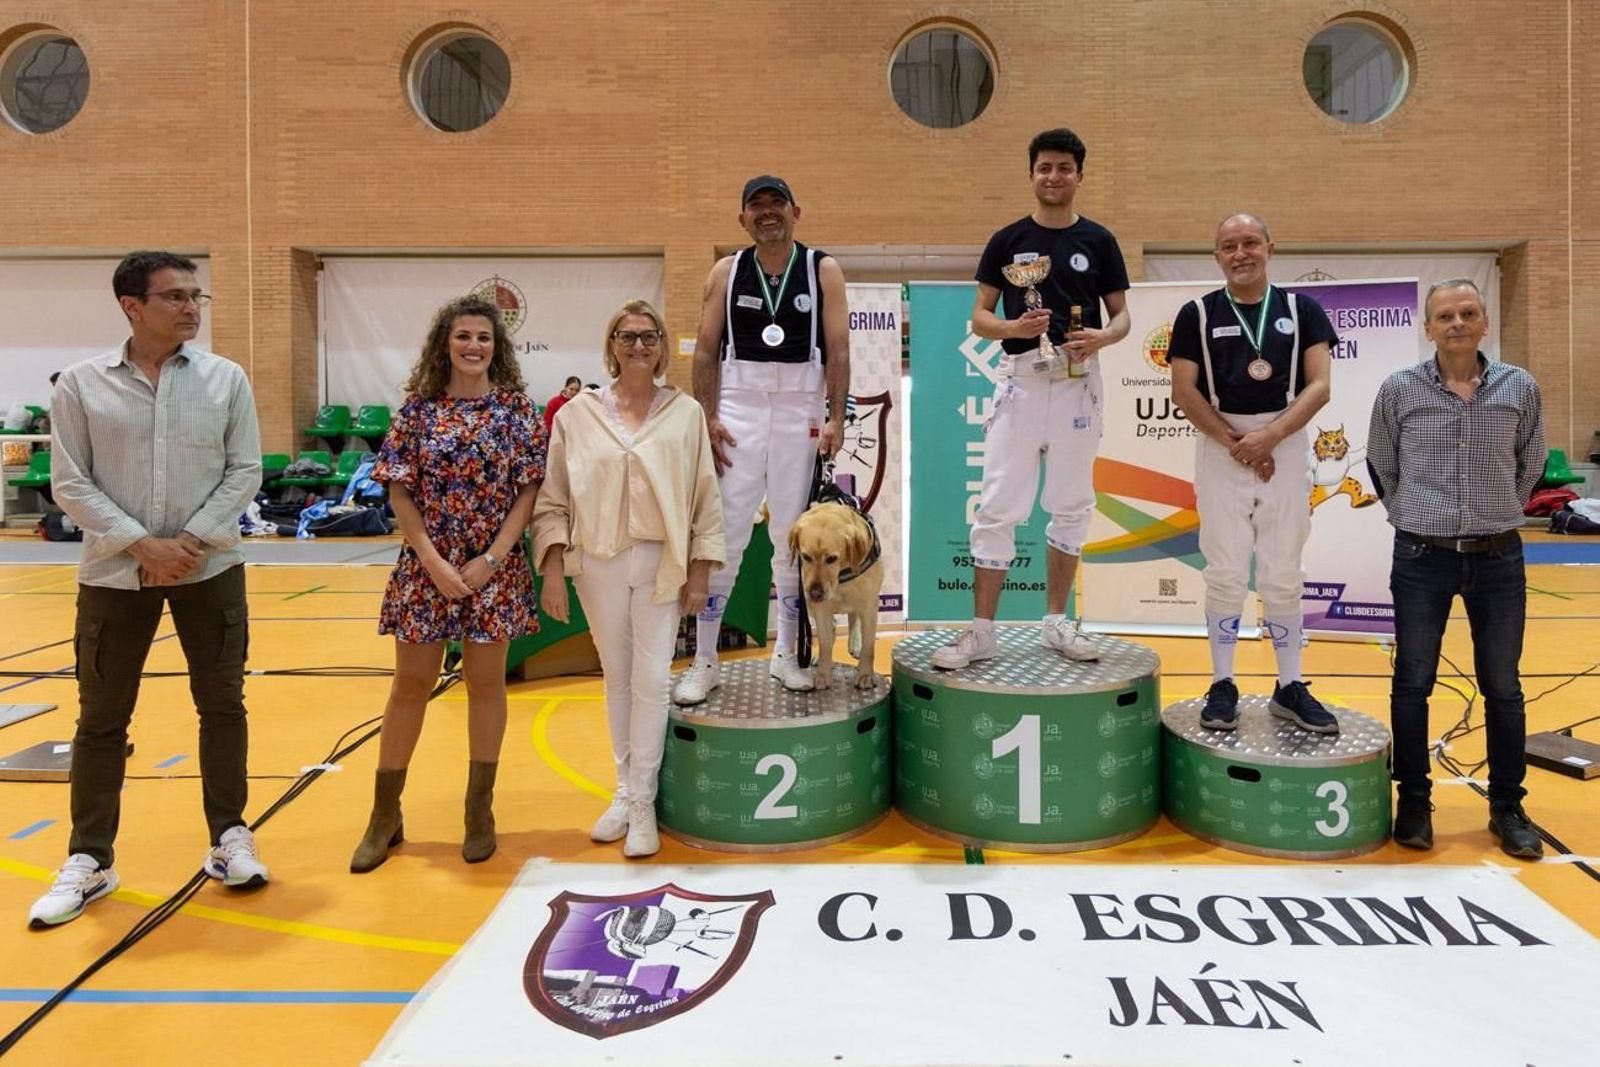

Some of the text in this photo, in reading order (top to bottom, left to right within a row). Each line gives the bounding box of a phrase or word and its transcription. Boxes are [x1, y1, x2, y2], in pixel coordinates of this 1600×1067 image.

[848, 311, 896, 331] GRIMA
[1337, 308, 1412, 328] ESGRIMA
[1330, 336, 1358, 359] ÉN
[1121, 377, 1171, 387] Universida
[1136, 424, 1200, 441] Deporte
[938, 578, 1046, 592] bule.ino.es
[1302, 586, 1339, 598] RIMA_JAEN
[991, 714, 1041, 824] 1
[753, 753, 798, 819] 2
[1315, 780, 1350, 838] 3
[817, 891, 1556, 947] C. D. ESGRIMA
[1104, 961, 1325, 1033] JAÉN
